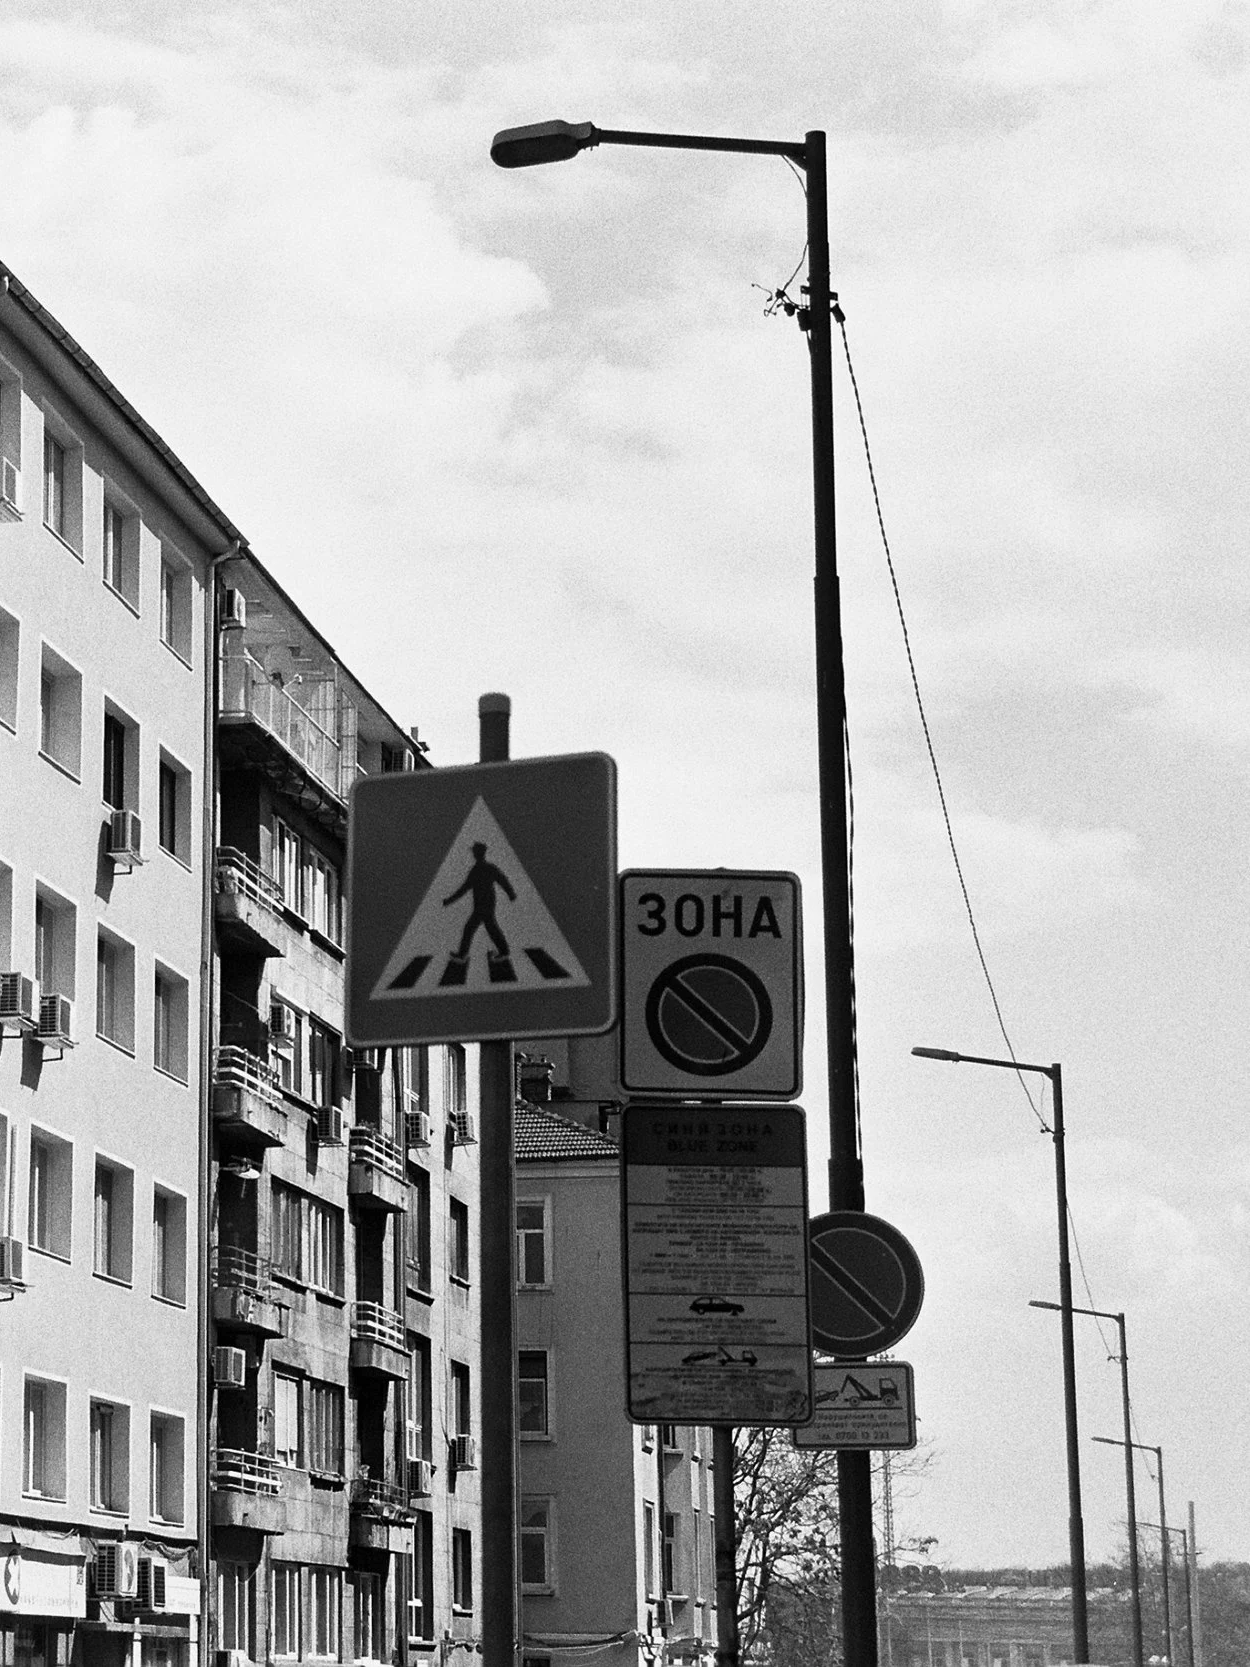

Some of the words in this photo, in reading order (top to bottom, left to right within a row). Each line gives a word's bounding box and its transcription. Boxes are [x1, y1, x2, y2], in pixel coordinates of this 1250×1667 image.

[637, 893, 782, 939] ЗОНА
[667, 1139, 709, 1152] BLUE
[716, 1140, 758, 1152] ZONE
